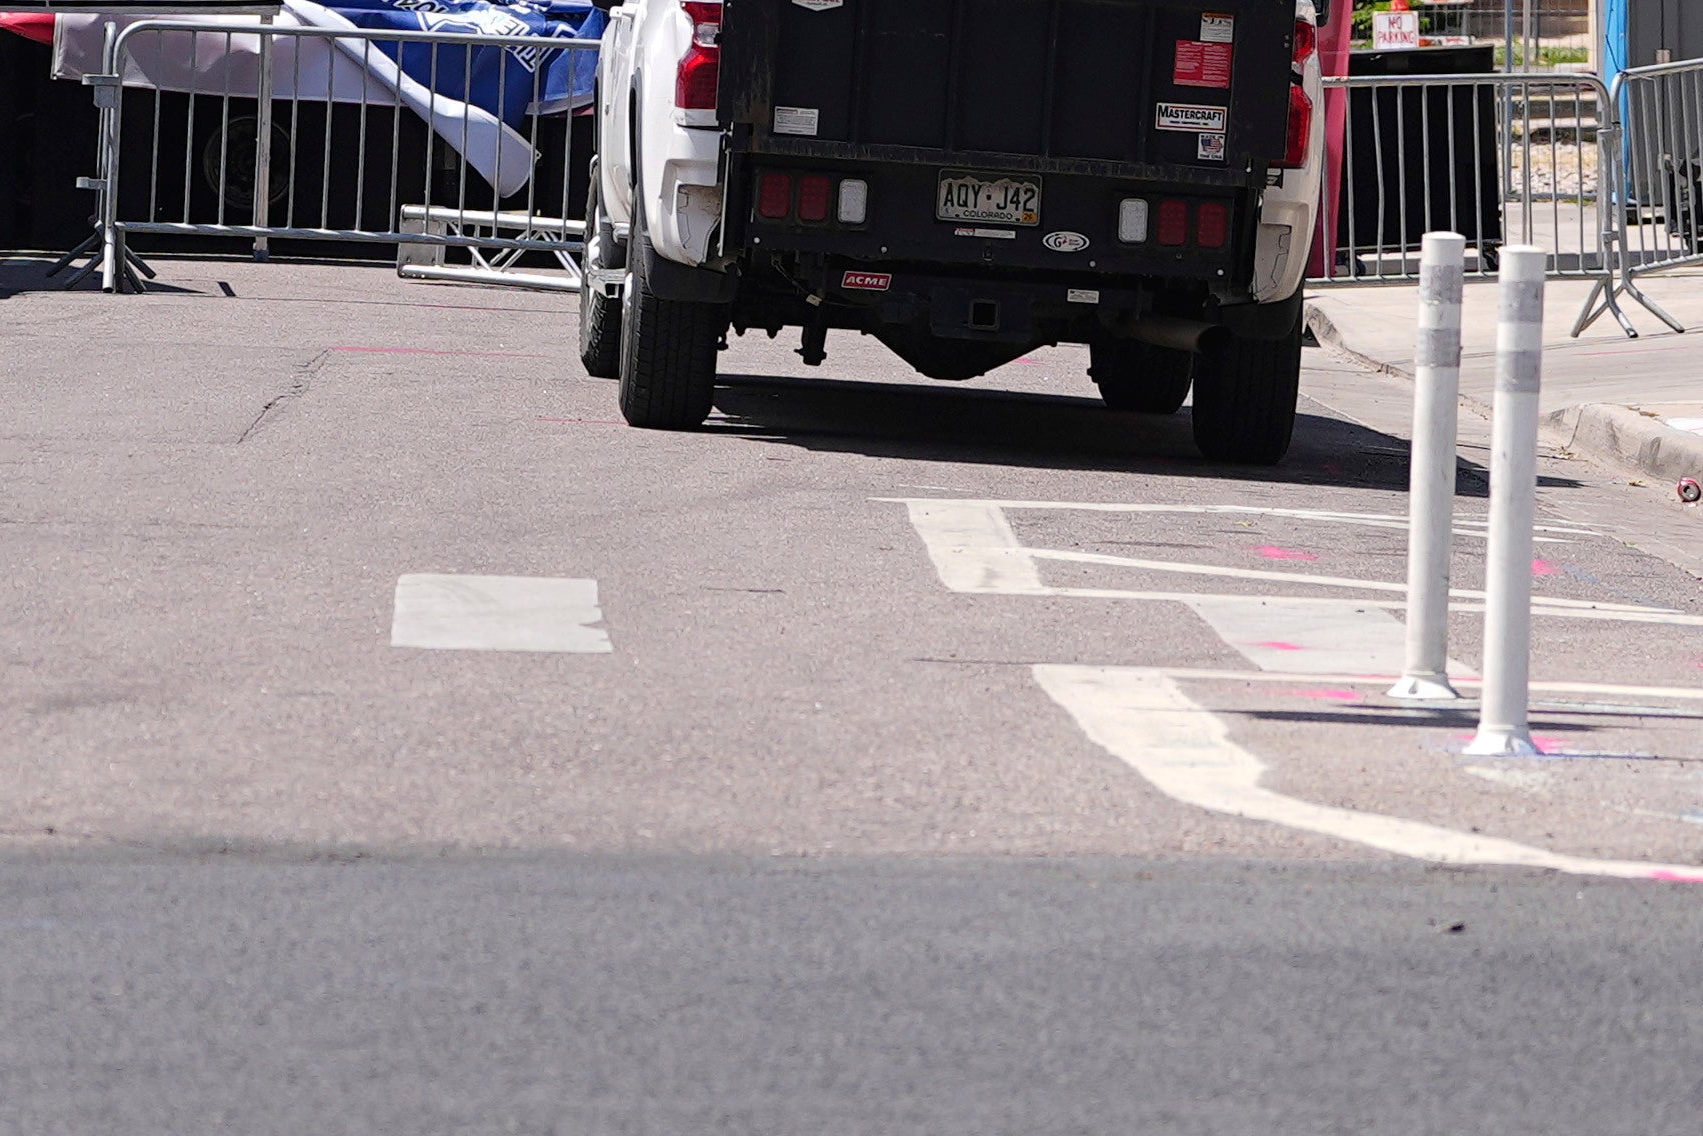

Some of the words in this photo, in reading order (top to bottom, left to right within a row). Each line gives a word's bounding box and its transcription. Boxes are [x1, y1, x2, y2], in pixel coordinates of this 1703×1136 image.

[1388, 16, 1403, 30] NO
[1378, 30, 1416, 45] PARKING
[962, 209, 1013, 220] COLORADO
[846, 275, 888, 287] ACME
